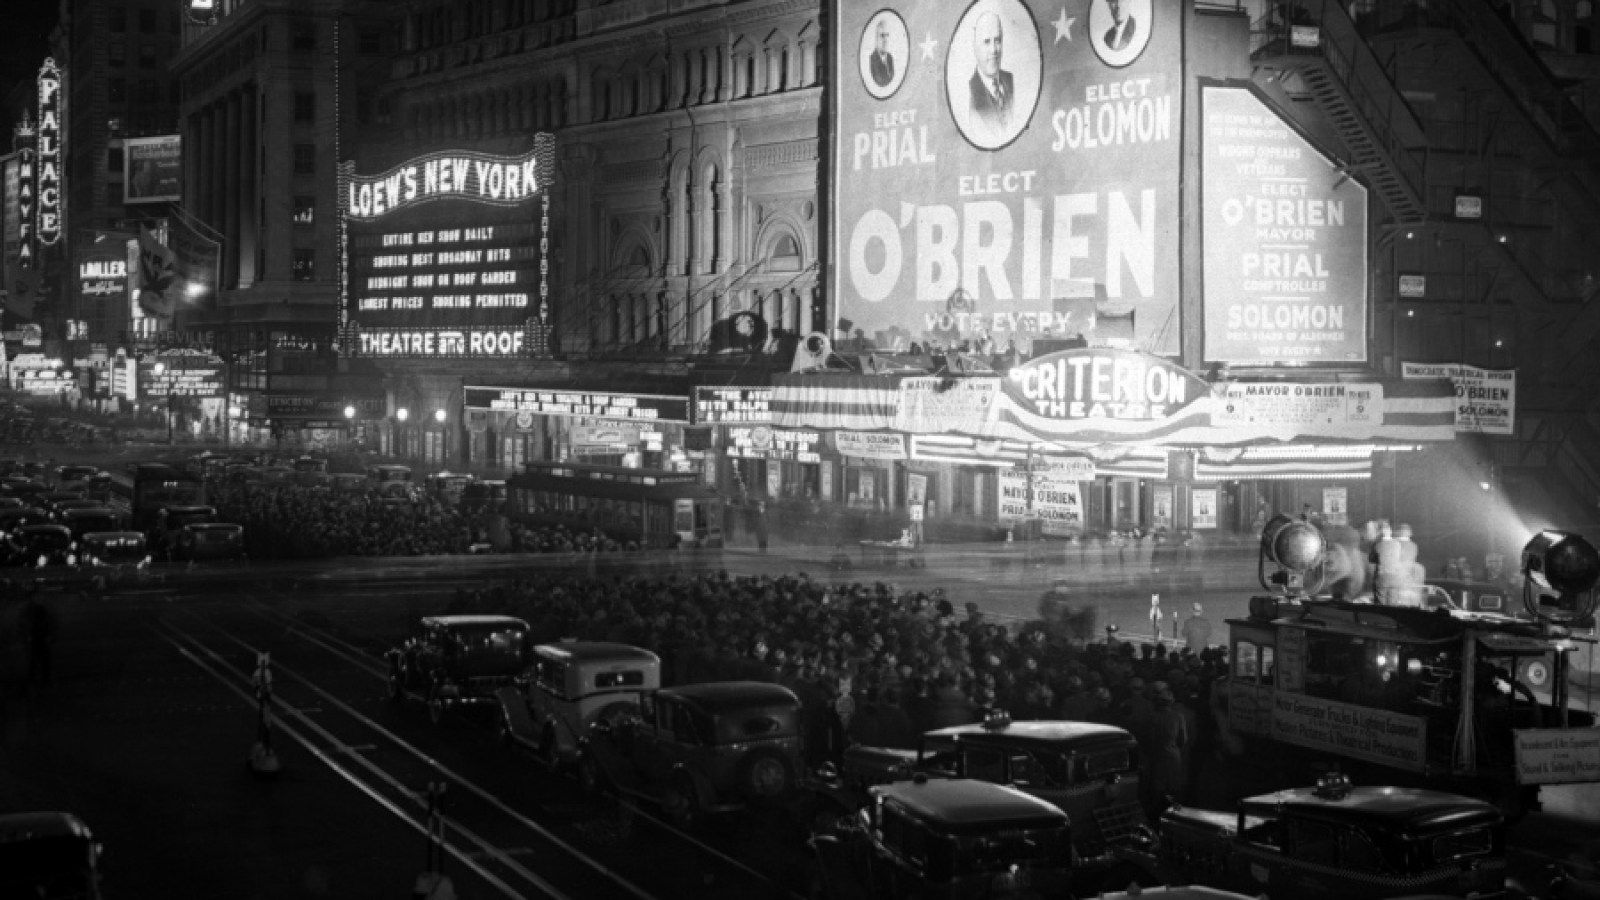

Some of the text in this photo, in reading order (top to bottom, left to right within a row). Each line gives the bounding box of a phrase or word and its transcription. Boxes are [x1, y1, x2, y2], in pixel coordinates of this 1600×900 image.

[1086, 79, 1150, 102] ELECT
[874, 110, 916, 127] ELECT
[1052, 96, 1170, 151] SOLOMON
[42, 79, 57, 231] PALACE
[854, 126, 935, 170] PRIAL
[350, 158, 537, 217] LOEW'S NEW YORK
[959, 171, 1035, 195] ELECT
[1261, 185, 1307, 196] ELECT
[20, 163, 31, 268] MAYFA
[1221, 197, 1344, 226] O'BRIEN
[438, 230, 460, 242] SHOW
[465, 227, 493, 240] DAILY
[1256, 229, 1316, 241] MAYOR
[850, 189, 1156, 301] O'BRIEN
[438, 250, 482, 264] BROADWAY
[487, 249, 510, 261] HITS
[1243, 253, 1329, 277] PRIAL
[412, 275, 433, 286] SHOW
[453, 273, 476, 285] ROOF
[481, 272, 516, 284] GARDEN
[392, 297, 423, 308] PRICES
[476, 294, 528, 308] PERMITTED
[926, 311, 1071, 333] VOTE EVERY
[1227, 305, 1344, 329] SOLOMON
[360, 332, 434, 353] THEATRE
[471, 331, 523, 353] ROOF
[1021, 357, 1186, 403] CRITERION
[1246, 386, 1289, 396] MAYOR
[1456, 386, 1509, 400] O'BRIEN
[1035, 402, 1165, 417] THEATRE
[1458, 406, 1509, 417] SOLOMON
[867, 435, 900, 445] SOLOMON
[1038, 490, 1076, 505] O'BRIEN
[1038, 509, 1078, 520] SOLOMON
